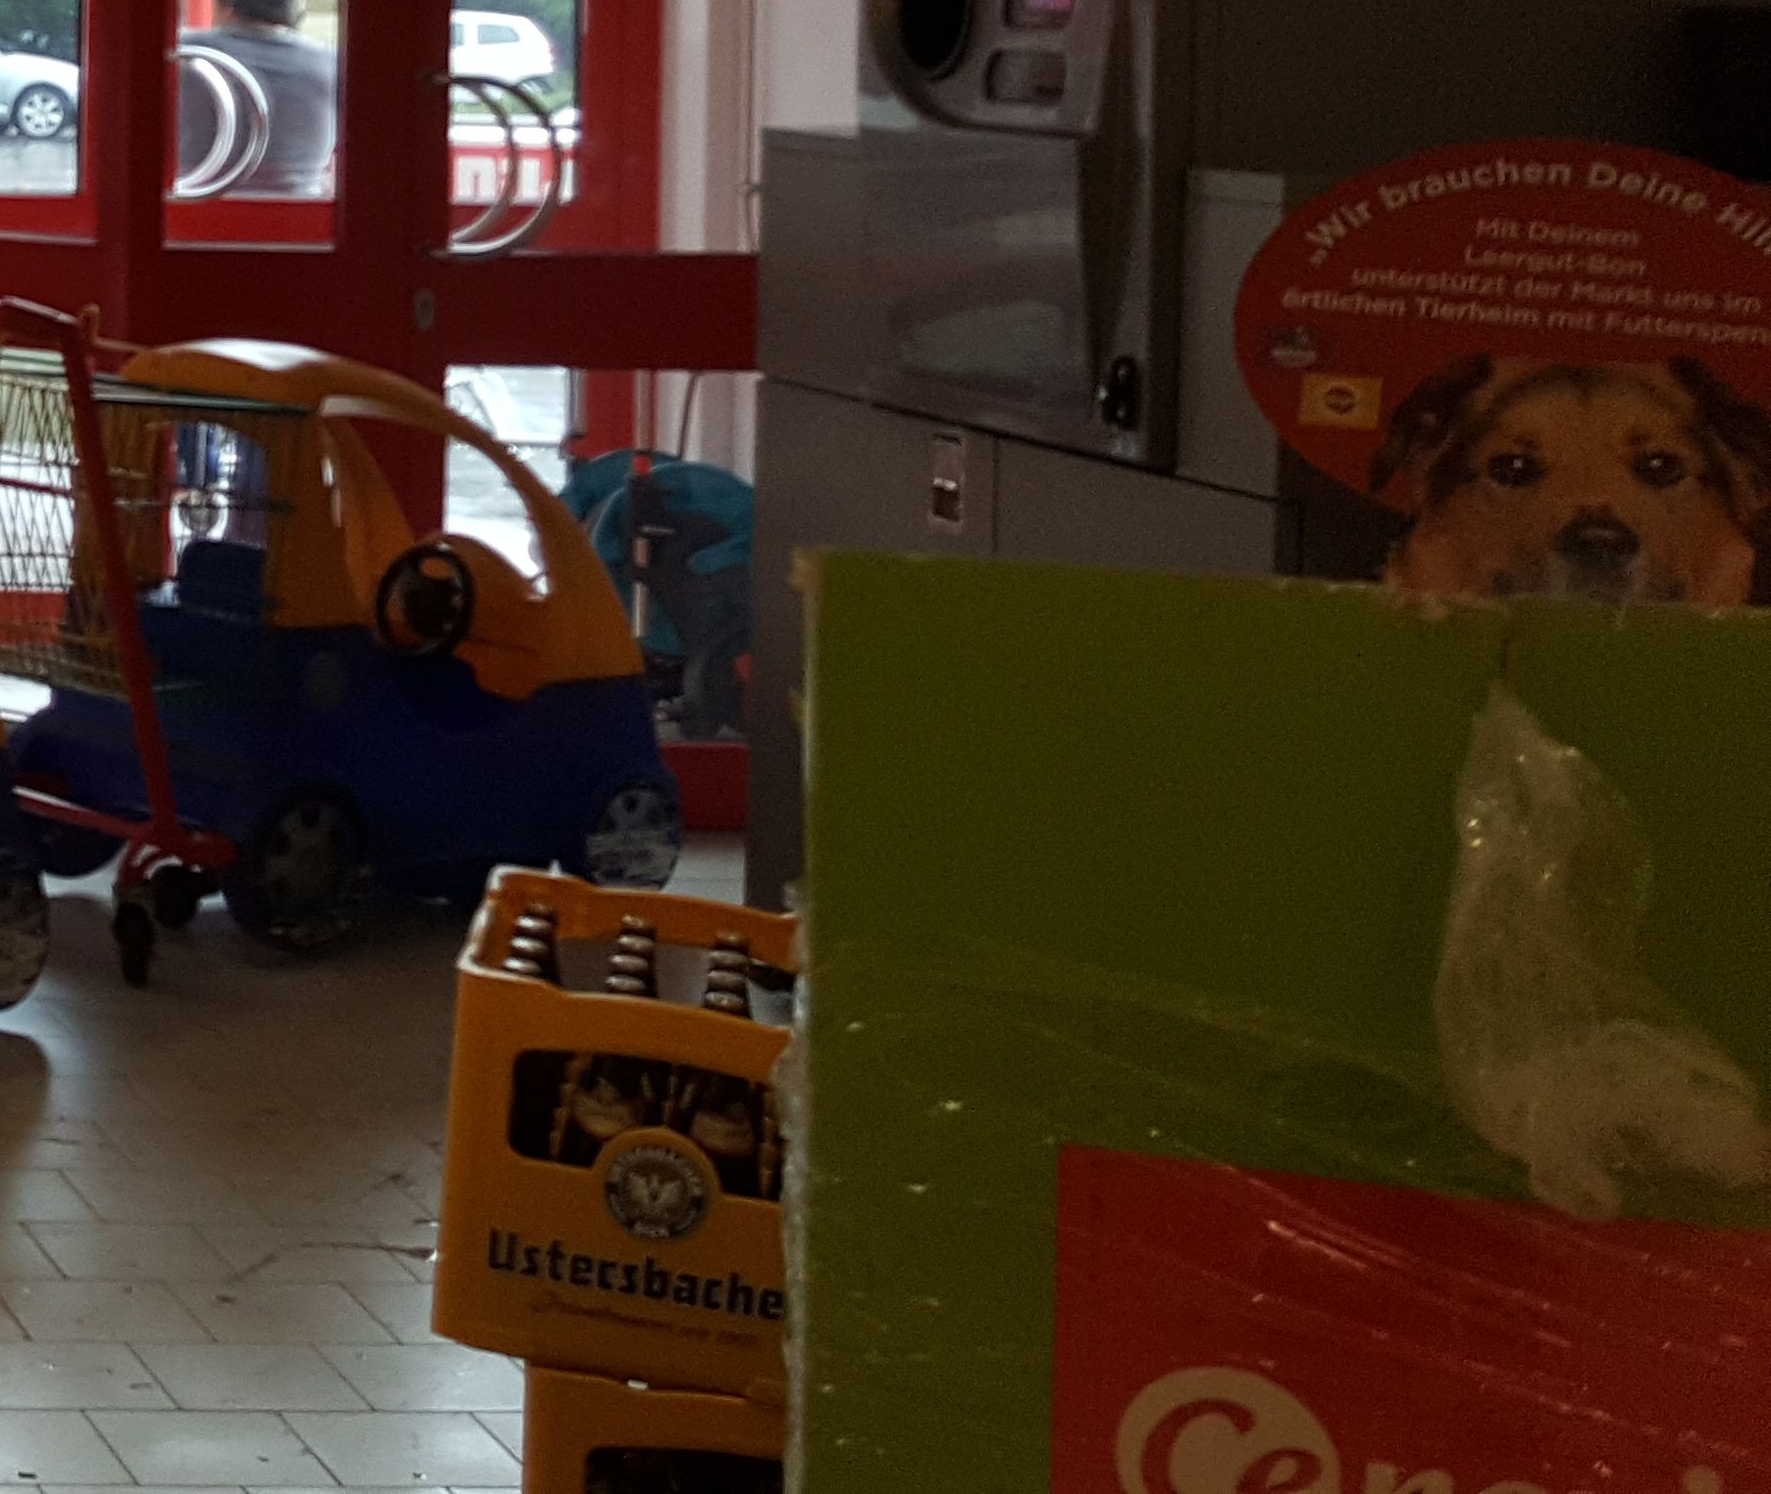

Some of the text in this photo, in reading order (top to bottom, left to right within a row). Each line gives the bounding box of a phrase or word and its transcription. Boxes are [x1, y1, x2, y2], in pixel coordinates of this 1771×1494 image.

[1378, 159, 1572, 212] brauchen
[1586, 161, 1709, 214] Deine
[1476, 218, 1642, 247] Mit Deinem
[1463, 245, 1647, 276] Leergut-Bon
[1281, 287, 1406, 317] örtlichen
[1416, 297, 1540, 326] Tierheim
[1546, 309, 1595, 332] mit
[1353, 269, 1507, 297] unterstützt
[1512, 278, 1561, 300] der
[1570, 282, 1654, 307] Markt
[1722, 291, 1763, 314] im
